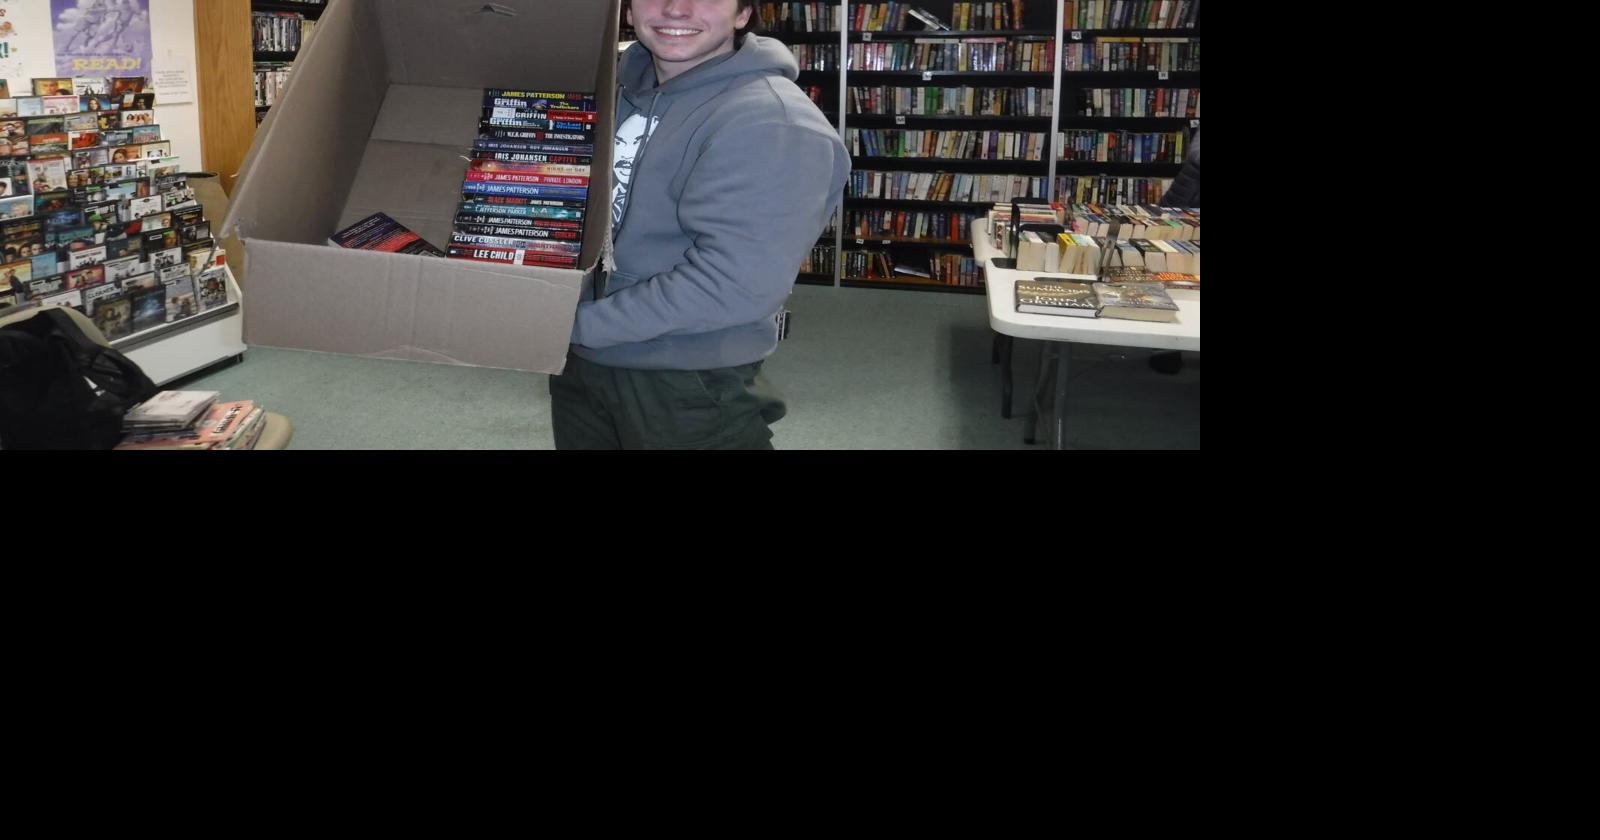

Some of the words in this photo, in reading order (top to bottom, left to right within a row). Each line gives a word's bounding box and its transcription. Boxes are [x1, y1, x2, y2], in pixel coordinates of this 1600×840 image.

[72, 57, 141, 71] READ!
[494, 98, 527, 107] Griffin
[490, 117, 522, 126] Griffin
[494, 152, 509, 160] IRIS
[511, 153, 547, 162] JOHANSEN
[486, 184, 506, 193] JAMES
[505, 186, 539, 195] PATTERSON
[503, 218, 532, 226] PATTERSON
[494, 227, 515, 235] JAMES
[514, 228, 549, 238] PATTERSON
[454, 235, 476, 243] CLIVE
[477, 236, 514, 245] CUSSLER
[473, 249, 489, 258] LEE
[489, 250, 515, 259] CHILD
